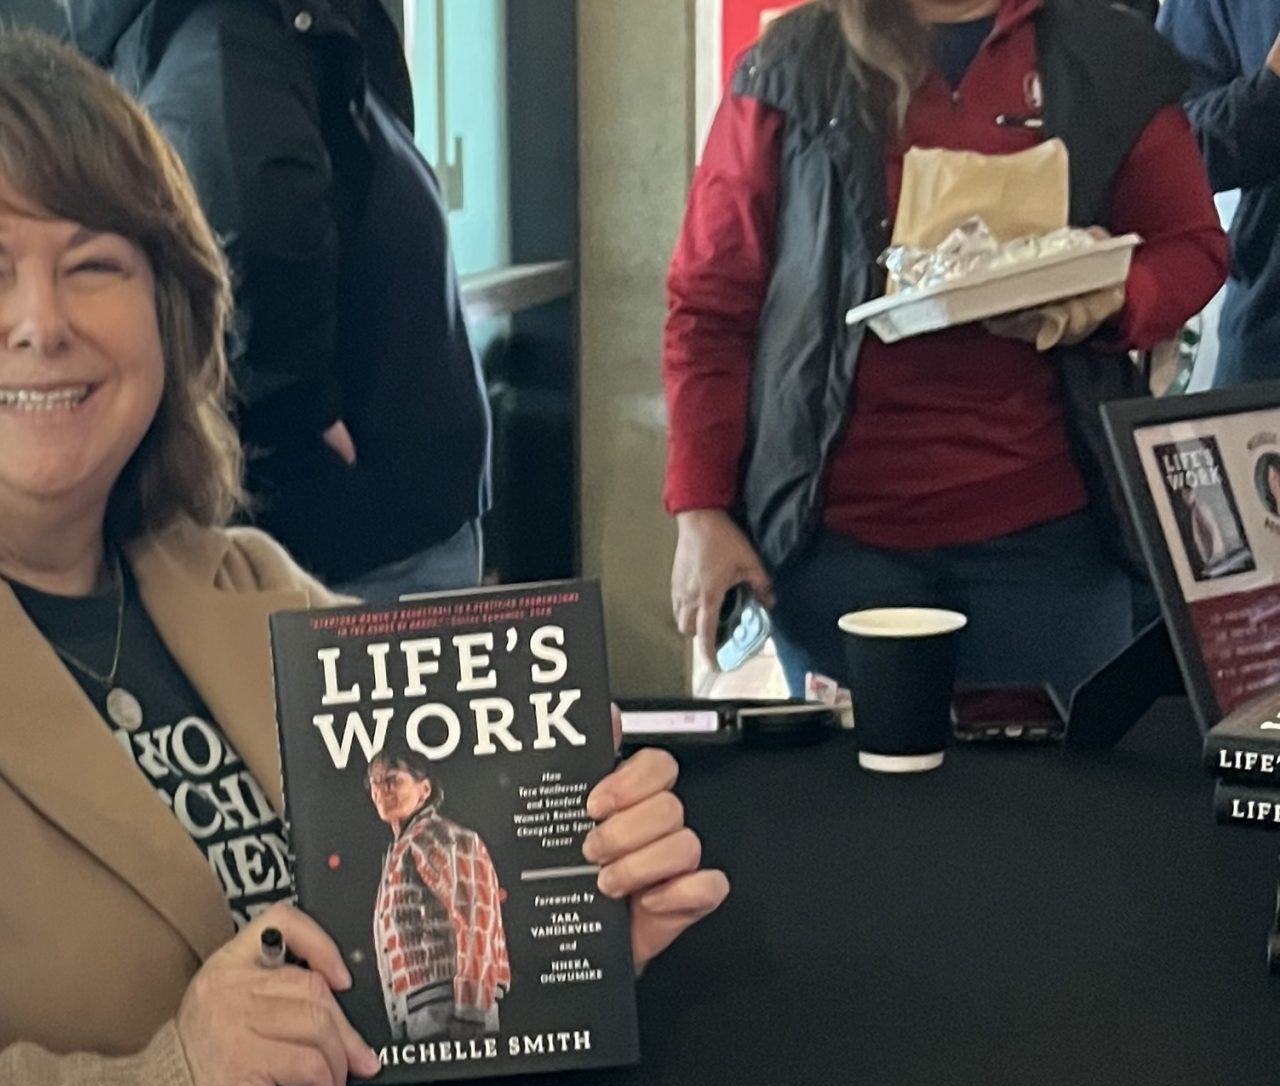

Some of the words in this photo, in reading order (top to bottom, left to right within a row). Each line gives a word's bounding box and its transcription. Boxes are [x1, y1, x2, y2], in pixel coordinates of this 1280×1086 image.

[317, 625, 568, 706] LIFE'S
[313, 689, 587, 769] WORK
[551, 911, 580, 924] TARA
[530, 920, 602, 938] VANDERVEER
[559, 940, 577, 952] and
[540, 968, 602, 984] OGWUMIKE
[508, 1030, 592, 1056] SMITH
